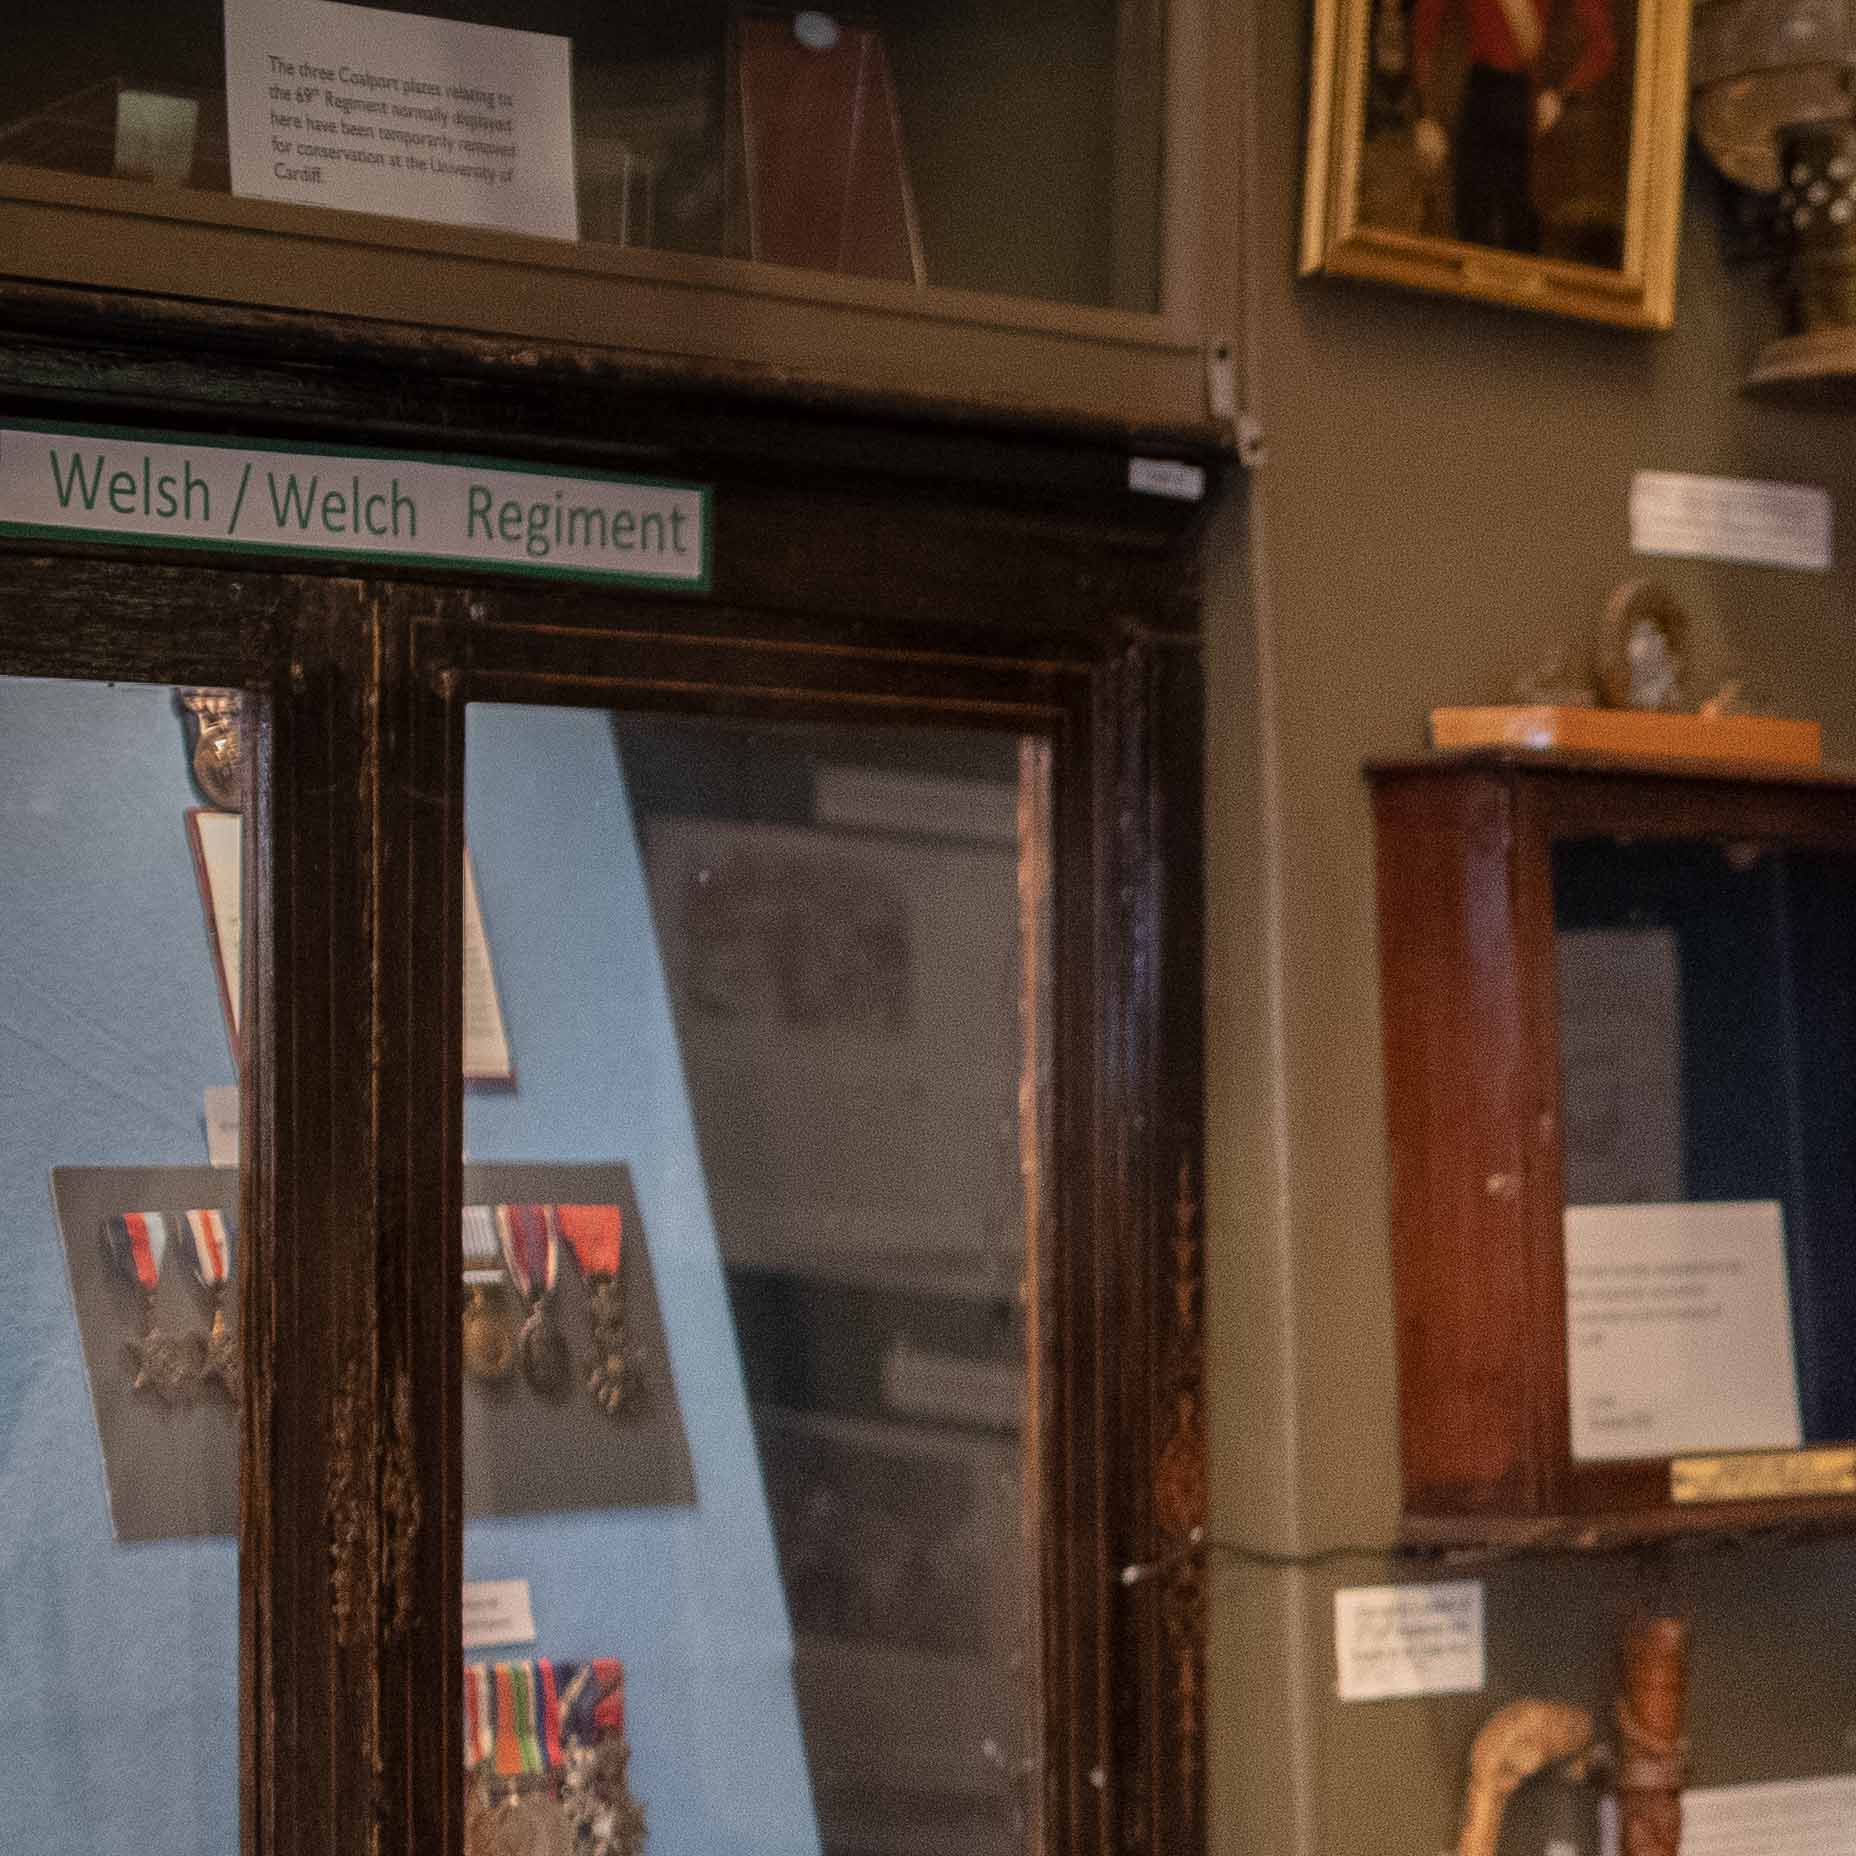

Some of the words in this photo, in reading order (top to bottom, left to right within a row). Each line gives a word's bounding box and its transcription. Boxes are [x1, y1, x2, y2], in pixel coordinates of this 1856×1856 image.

[268, 55, 294, 77] The
[300, 62, 335, 82] three
[339, 66, 399, 95] Coalport
[269, 84, 294, 102] the
[325, 91, 388, 117] Regiment
[392, 103, 447, 128] normally
[271, 112, 302, 131] here
[306, 115, 337, 134] have
[341, 120, 374, 141] been
[272, 136, 295, 154] for
[297, 143, 384, 166] conservation
[406, 153, 428, 170] the
[431, 159, 495, 185] University
[49, 449, 210, 521] Welsh
[266, 469, 417, 538] Welch
[466, 483, 688, 557] Regiment
